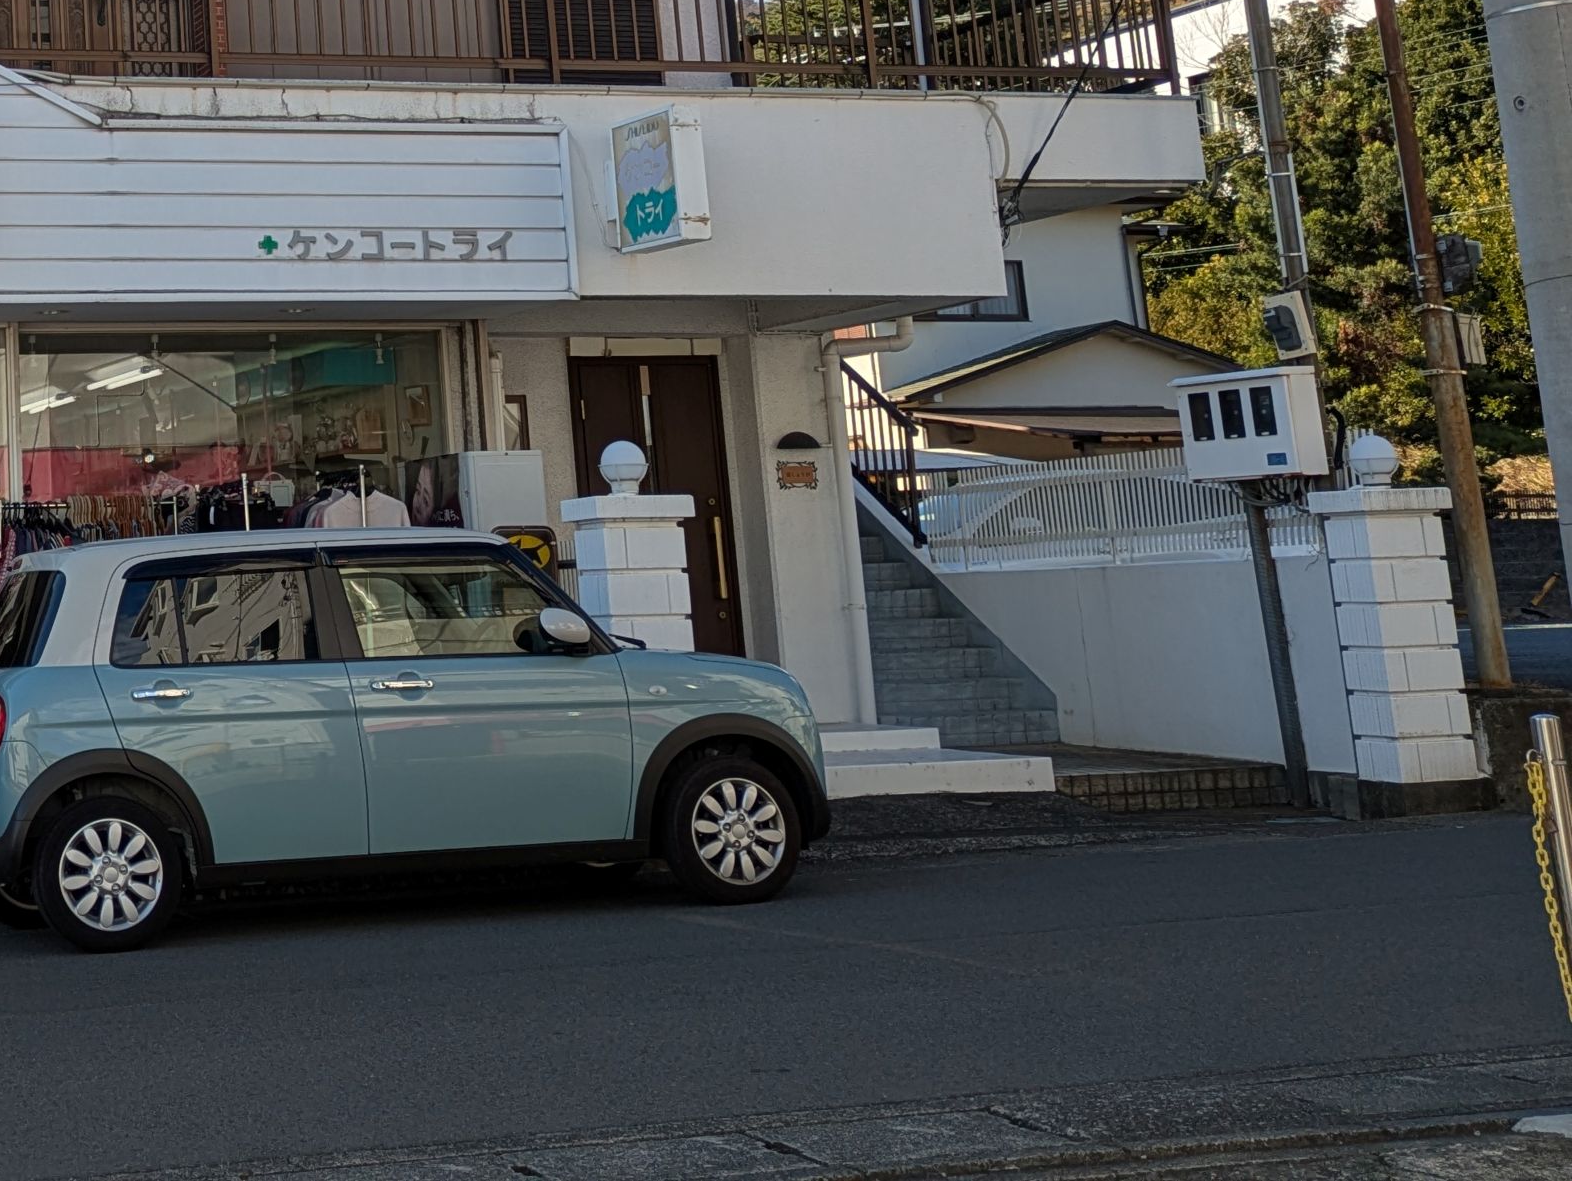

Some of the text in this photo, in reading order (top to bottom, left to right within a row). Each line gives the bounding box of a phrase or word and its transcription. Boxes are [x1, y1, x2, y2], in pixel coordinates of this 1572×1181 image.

[636, 199, 663, 226] トライ
[288, 230, 513, 260] ケンコートライ
